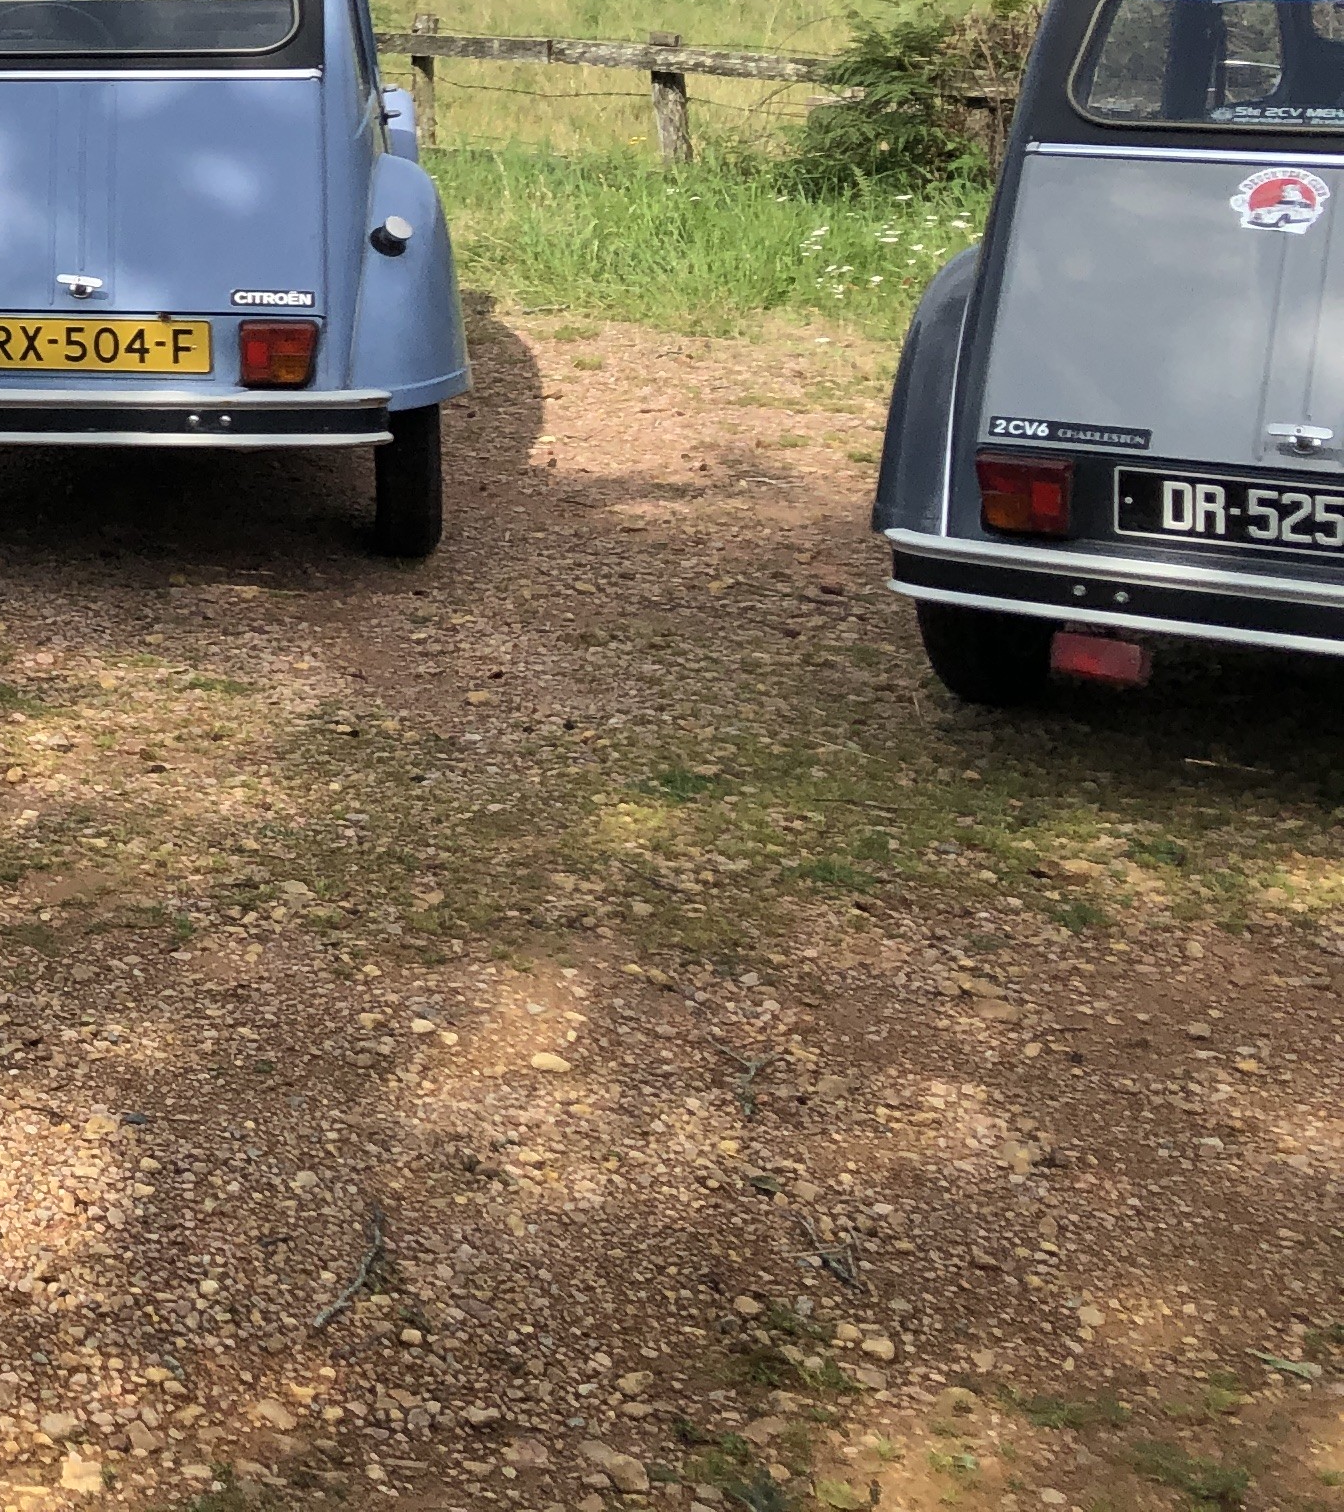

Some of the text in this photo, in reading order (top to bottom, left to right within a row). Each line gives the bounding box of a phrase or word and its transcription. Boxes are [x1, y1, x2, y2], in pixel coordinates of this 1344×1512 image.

[233, 290, 313, 306] CITROËN
[992, 419, 1147, 446] 2CV6 CHARLESTON
[1161, 480, 1344, 547] DR-525
